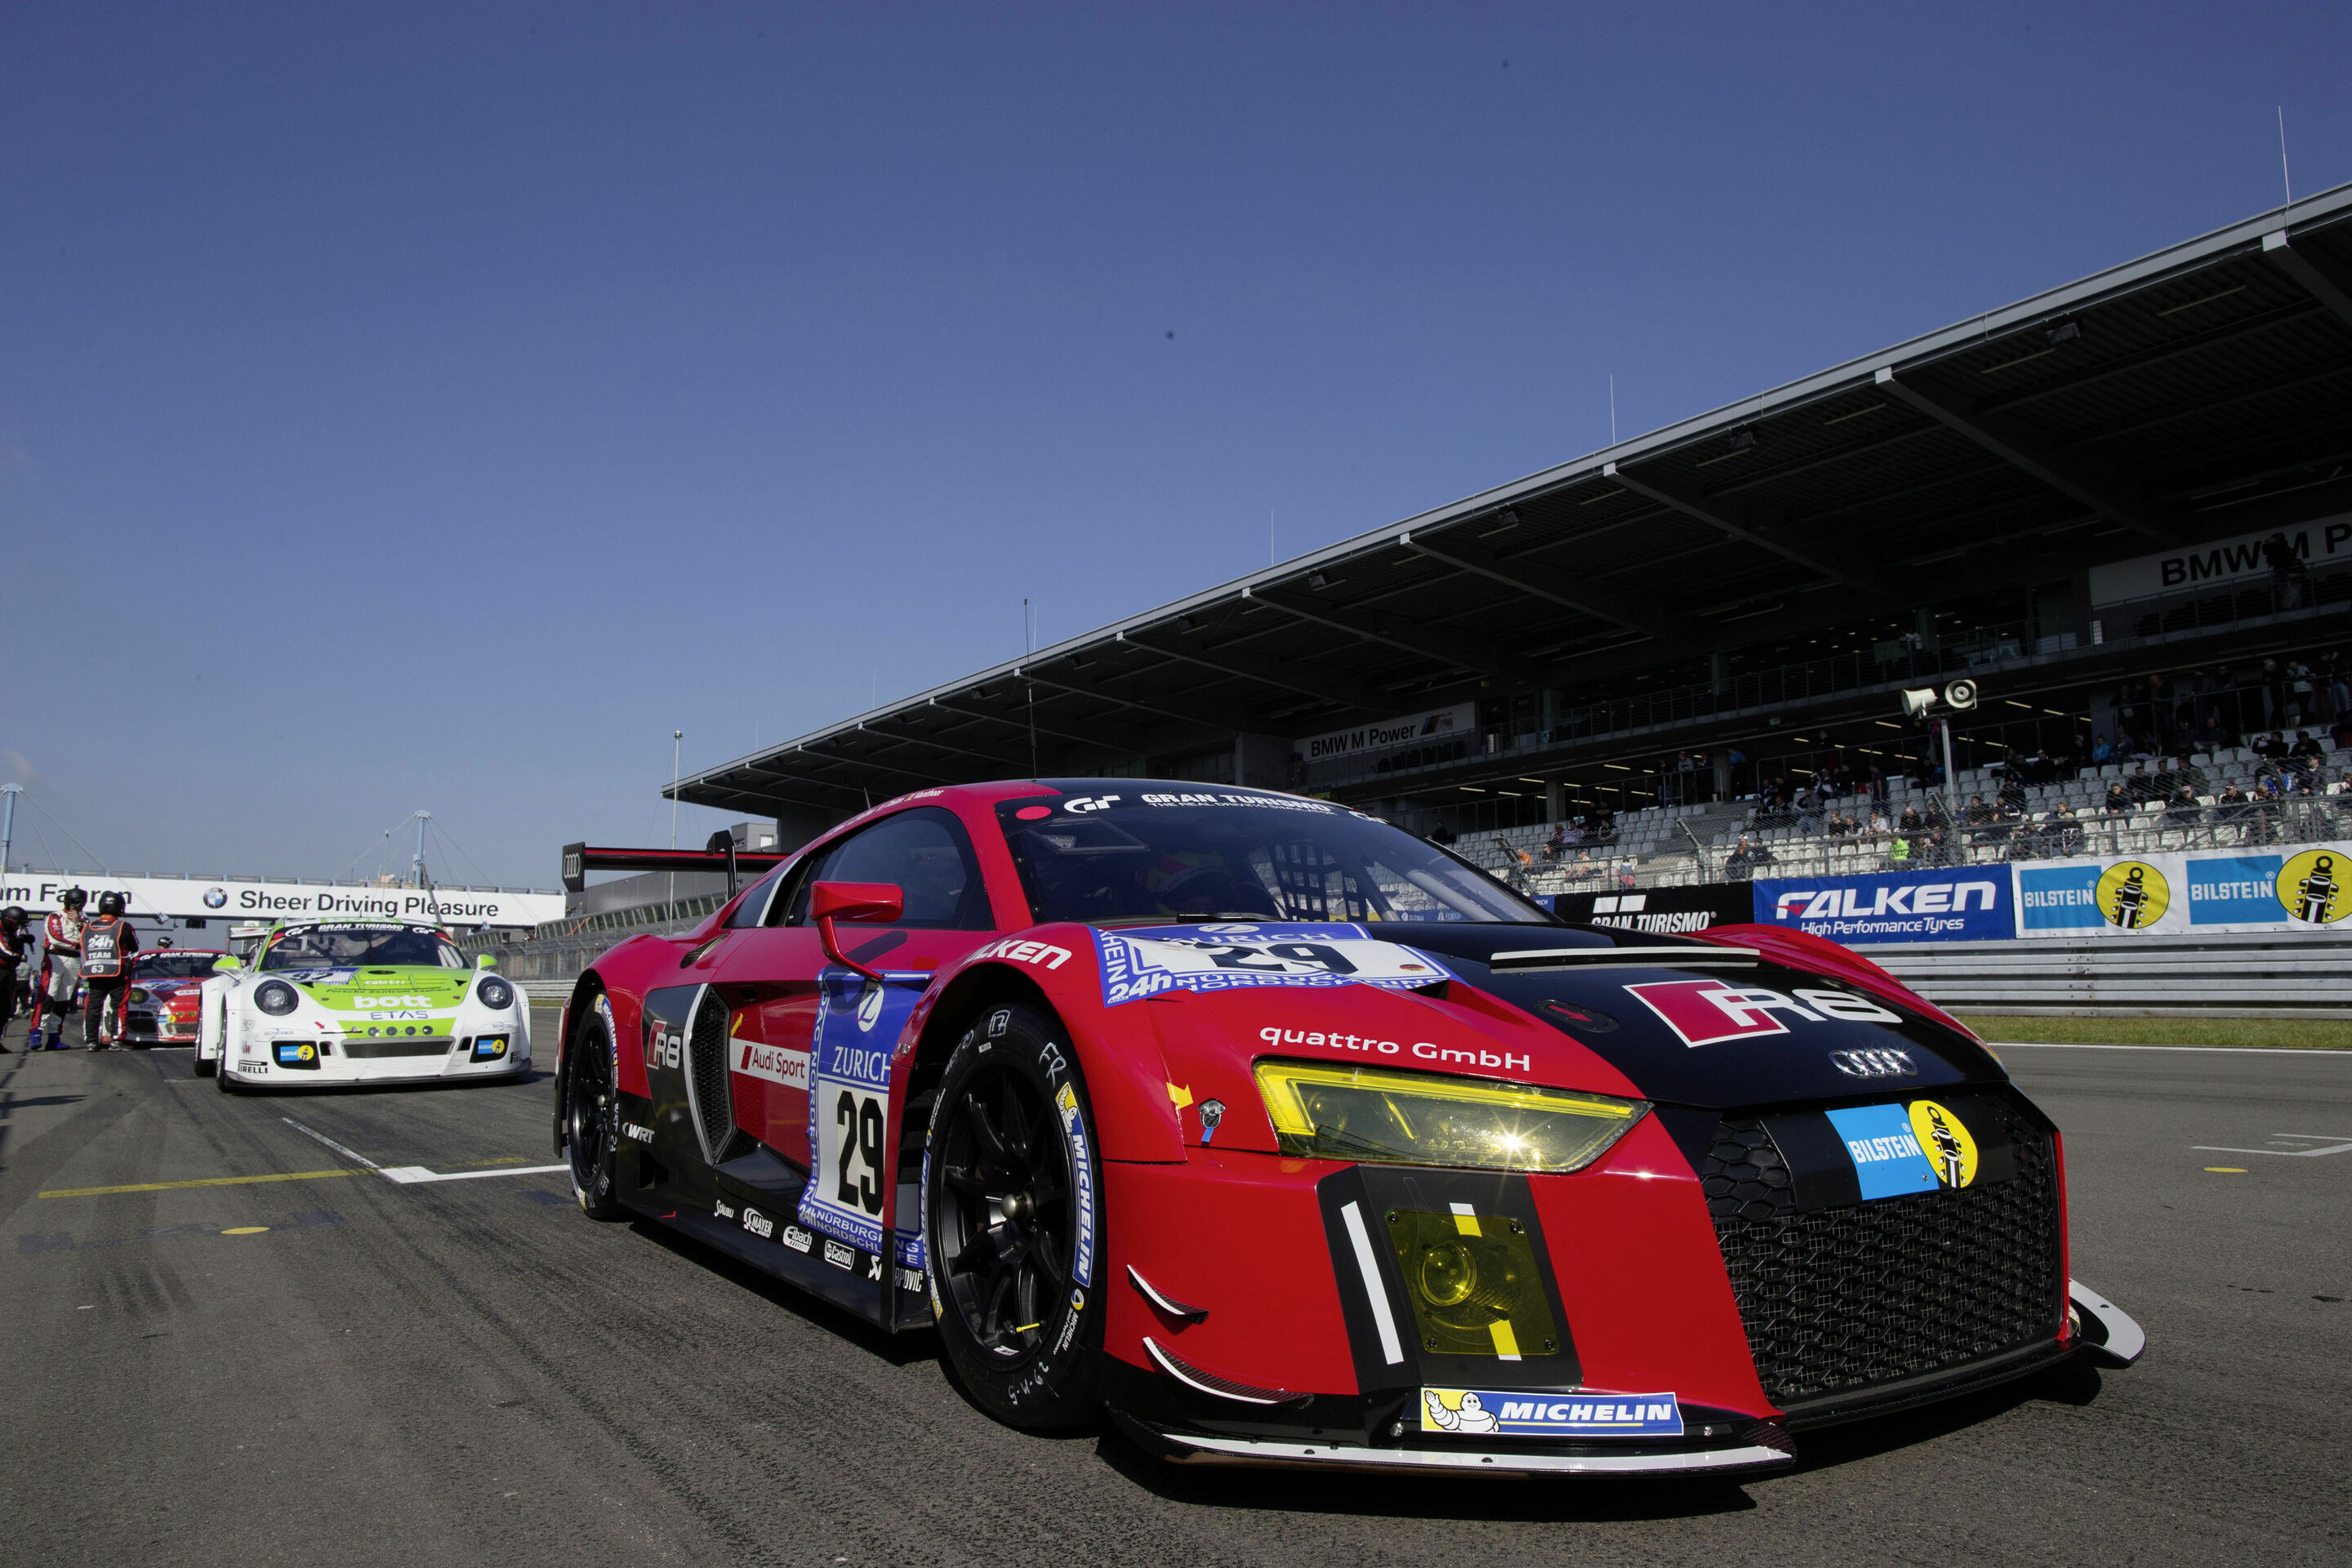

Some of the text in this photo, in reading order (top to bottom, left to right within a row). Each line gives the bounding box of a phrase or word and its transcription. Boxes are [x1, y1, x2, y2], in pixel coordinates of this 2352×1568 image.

[2161, 541, 2261, 586] BMW
[1311, 724, 1416, 757] BMW M Power
[1141, 794, 1218, 803] GRAN
[1219, 795, 1330, 812] TURISMO
[0, 883, 131, 904] m Farn
[239, 890, 499, 916] Sheer Driving Pleasure
[1775, 880, 1997, 920] FALKEN
[2025, 889, 2094, 908] BILSTEIN
[2191, 880, 2274, 901] BILSTEIN
[1637, 911, 1709, 933] TURISMO
[1801, 916, 1964, 938] High Performance Tyres
[87, 938, 114, 949] 24h
[964, 939, 1072, 970] LKEN
[91, 964, 105, 973] 63
[1178, 942, 1358, 974] 29
[1109, 973, 1172, 1004] 24h
[353, 995, 433, 1009] bott
[371, 1010, 428, 1020] ETAS
[1696, 987, 1904, 1027] R8
[654, 1031, 681, 1069] R8
[1260, 1027, 1530, 1071] quattro GmbH
[751, 1048, 805, 1079] Audi Sport
[832, 1046, 893, 1083] ZURICH
[628, 1123, 655, 1143] WRT
[837, 1090, 884, 1216] 29
[1848, 1134, 1922, 1164] BILSTEIN
[799, 1203, 817, 1227] 24h
[1073, 1134, 1091, 1280] MICHELIN
[751, 1214, 773, 1234] MAYER
[783, 1225, 813, 1246] Eibach
[831, 1244, 852, 1266] Castrol
[894, 1267, 924, 1293] APOVIČ
[1062, 1312, 1079, 1352] MICHELIN
[1499, 1401, 1672, 1421] MICHELIN
